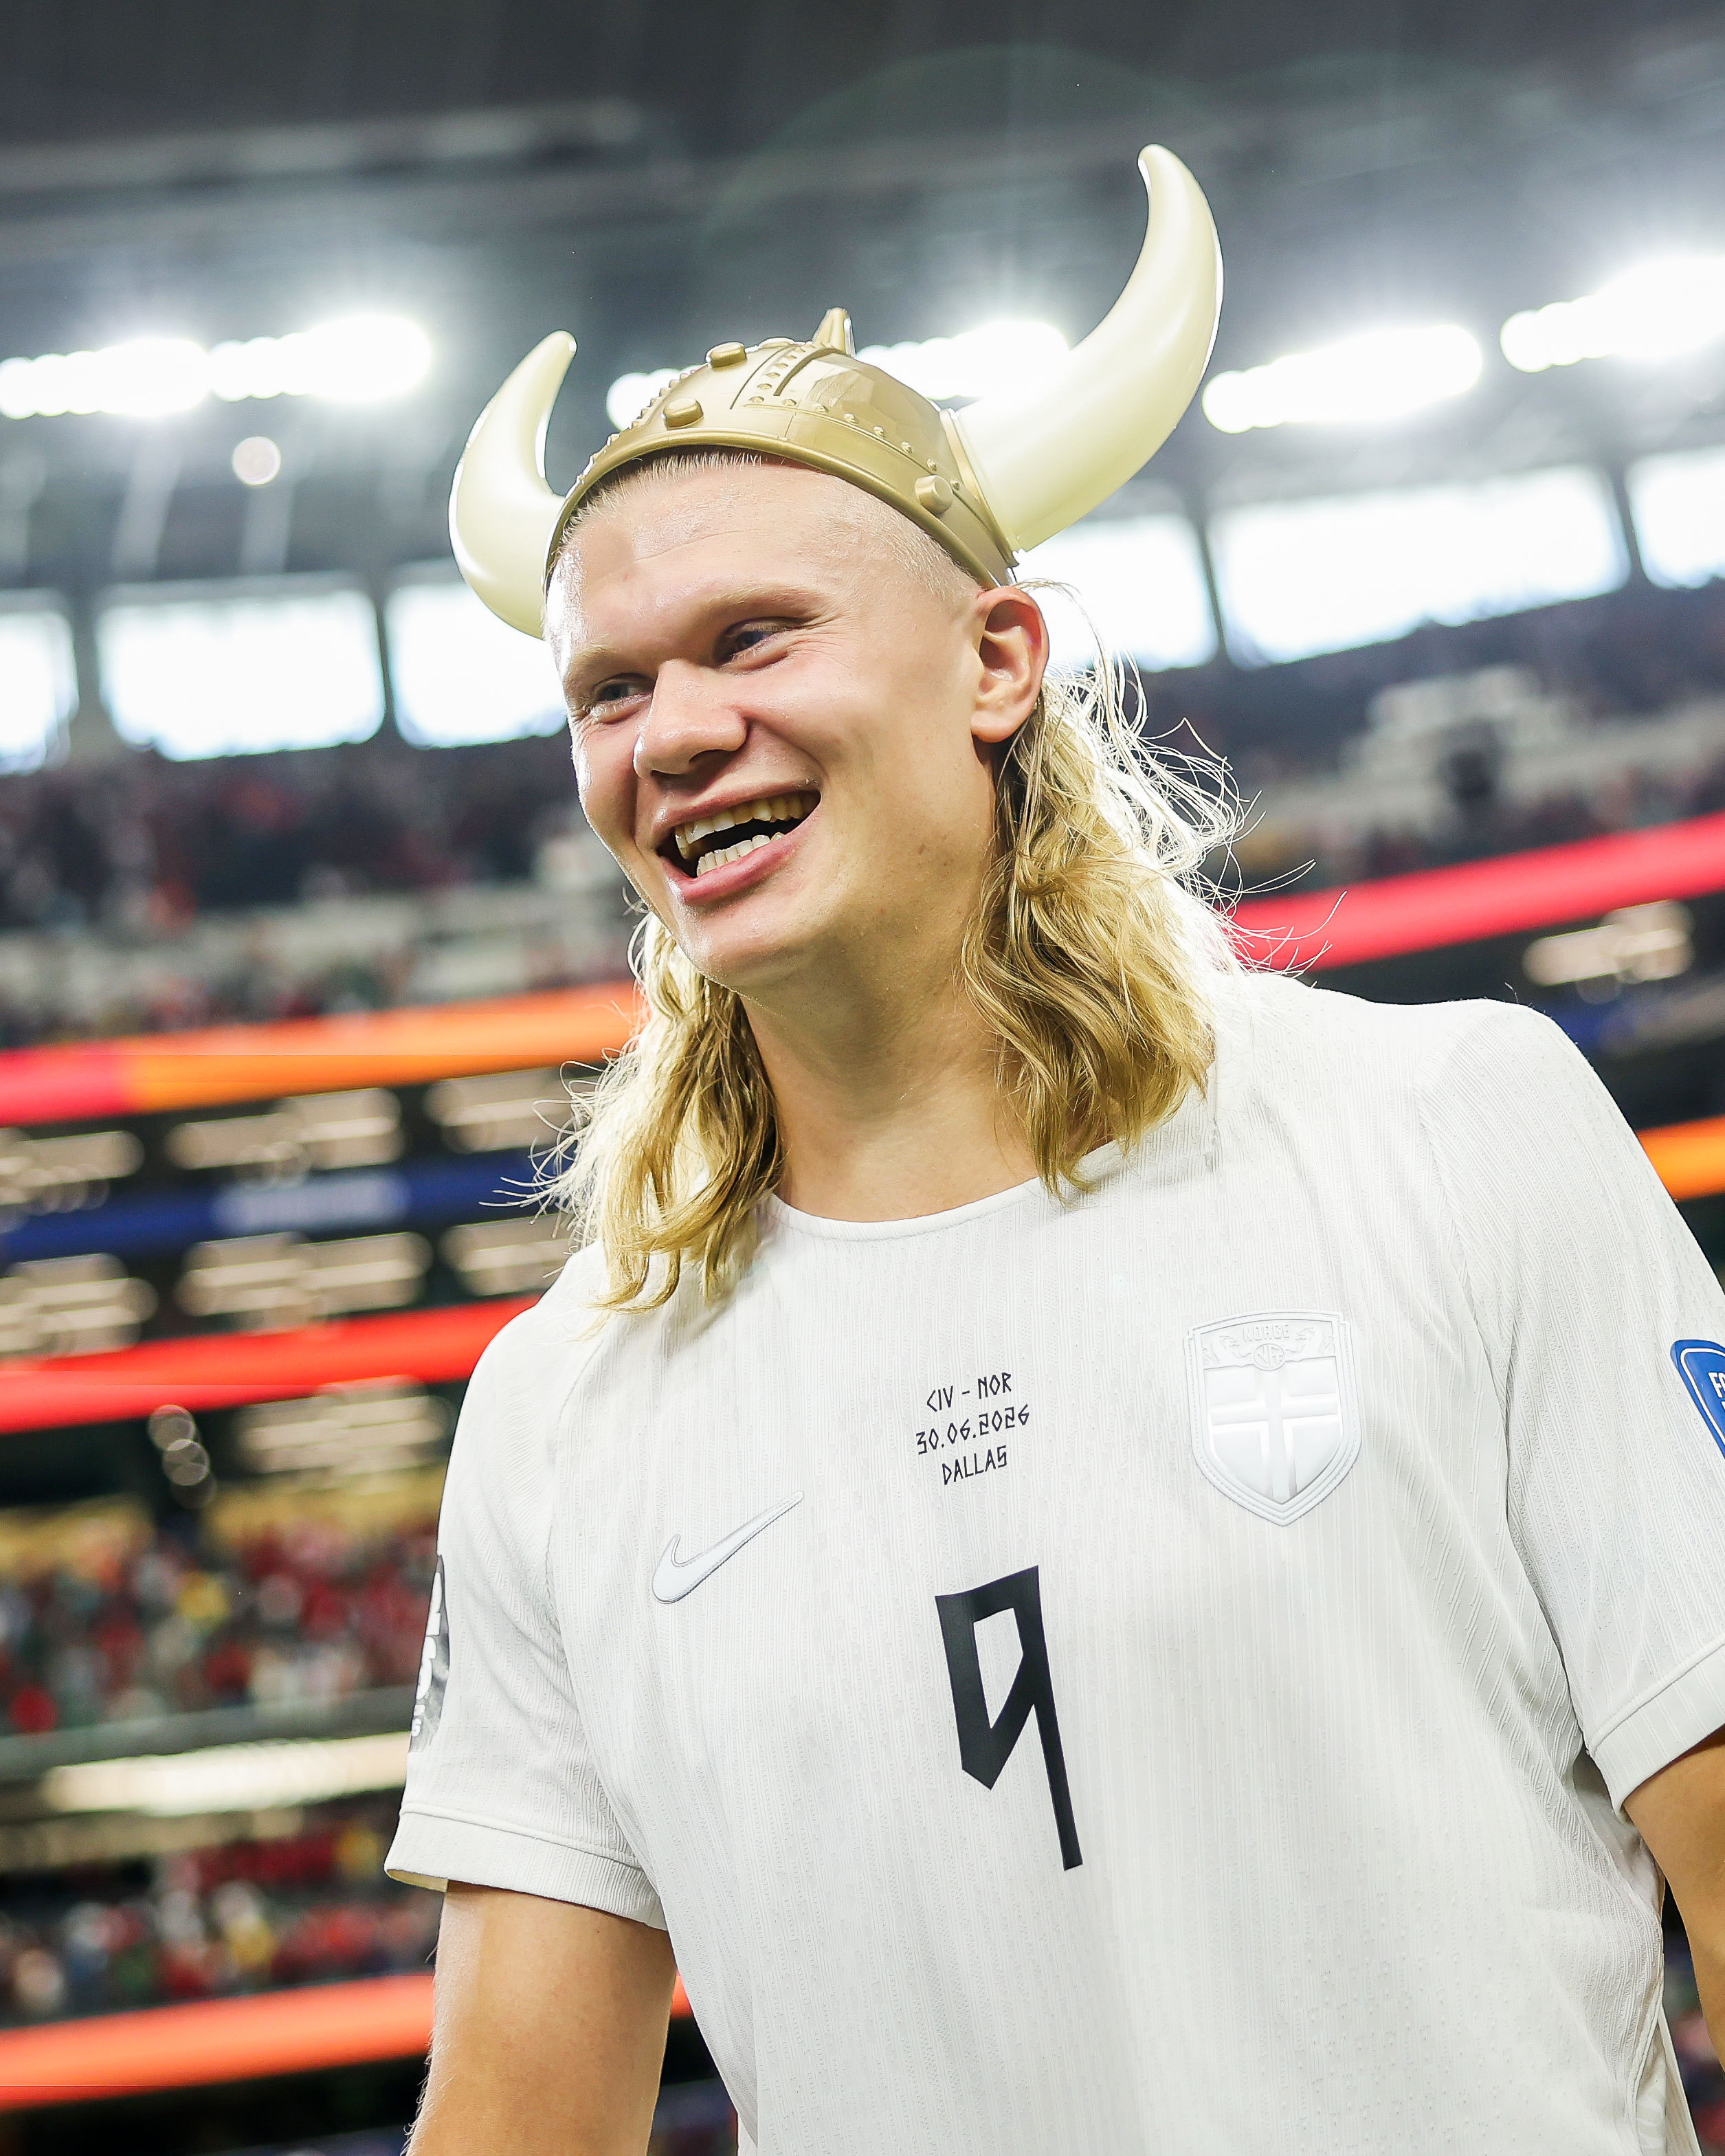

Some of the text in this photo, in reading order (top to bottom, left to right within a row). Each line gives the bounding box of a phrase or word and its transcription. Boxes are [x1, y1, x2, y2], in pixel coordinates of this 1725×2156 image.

[1243, 1324, 1290, 1342] NORGE
[926, 1385, 954, 1413] CIV
[977, 1372, 1012, 1400] NOR
[915, 1403, 1030, 1456] 30.06.2026
[942, 1445, 1008, 1485] DALLAS
[934, 1564, 1084, 1872] 9
